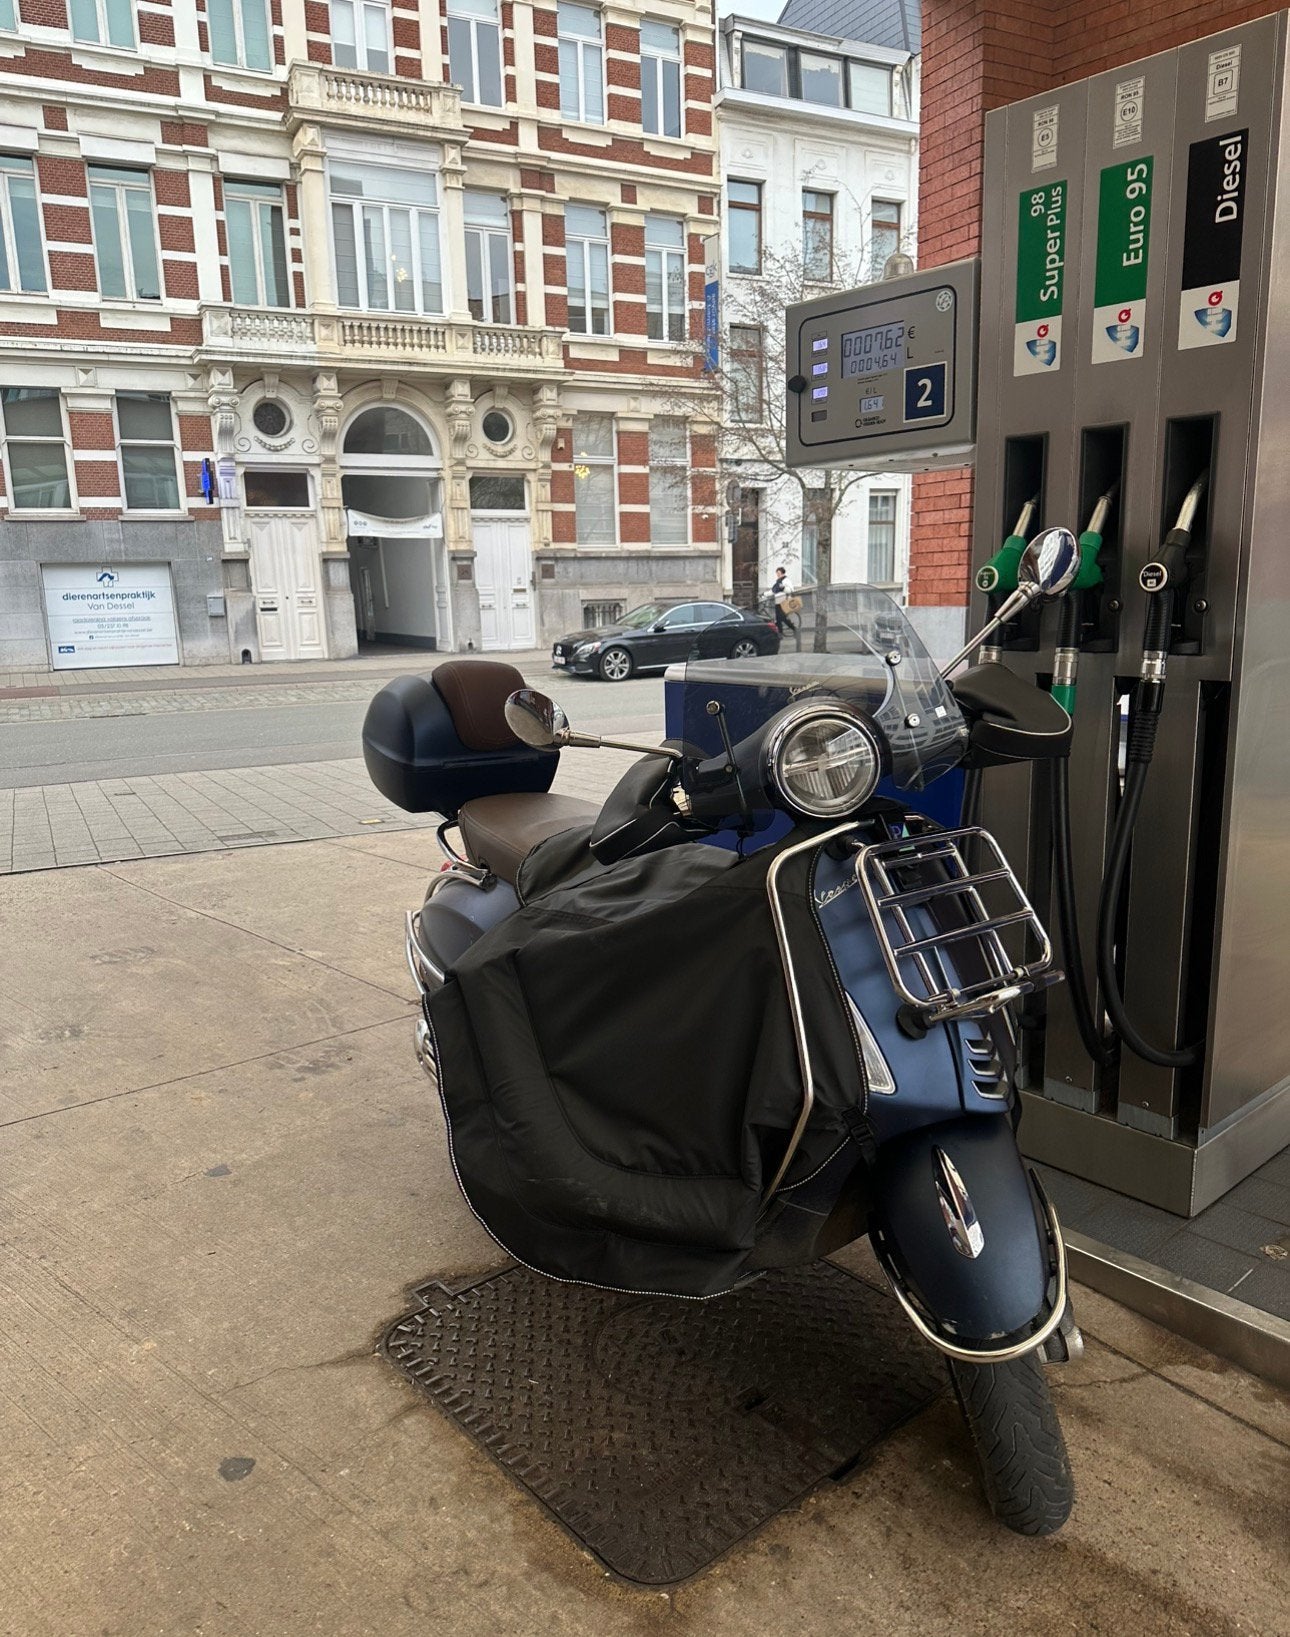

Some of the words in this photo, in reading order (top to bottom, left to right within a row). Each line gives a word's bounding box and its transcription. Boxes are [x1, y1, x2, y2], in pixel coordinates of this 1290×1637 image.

[1218, 77, 1228, 87] B7
[1123, 106, 1136, 116] E10
[1126, 163, 1148, 199] 95
[1215, 135, 1242, 223] Diesel
[1031, 191, 1045, 217] 98
[1122, 205, 1146, 267] Euro
[907, 326, 916, 339] €
[907, 347, 914, 359] L
[917, 378, 932, 408] 2
[62, 591, 156, 601] dierenartsenpraktijk
[87, 603, 105, 611] Van
[107, 602, 135, 610] Dessel
